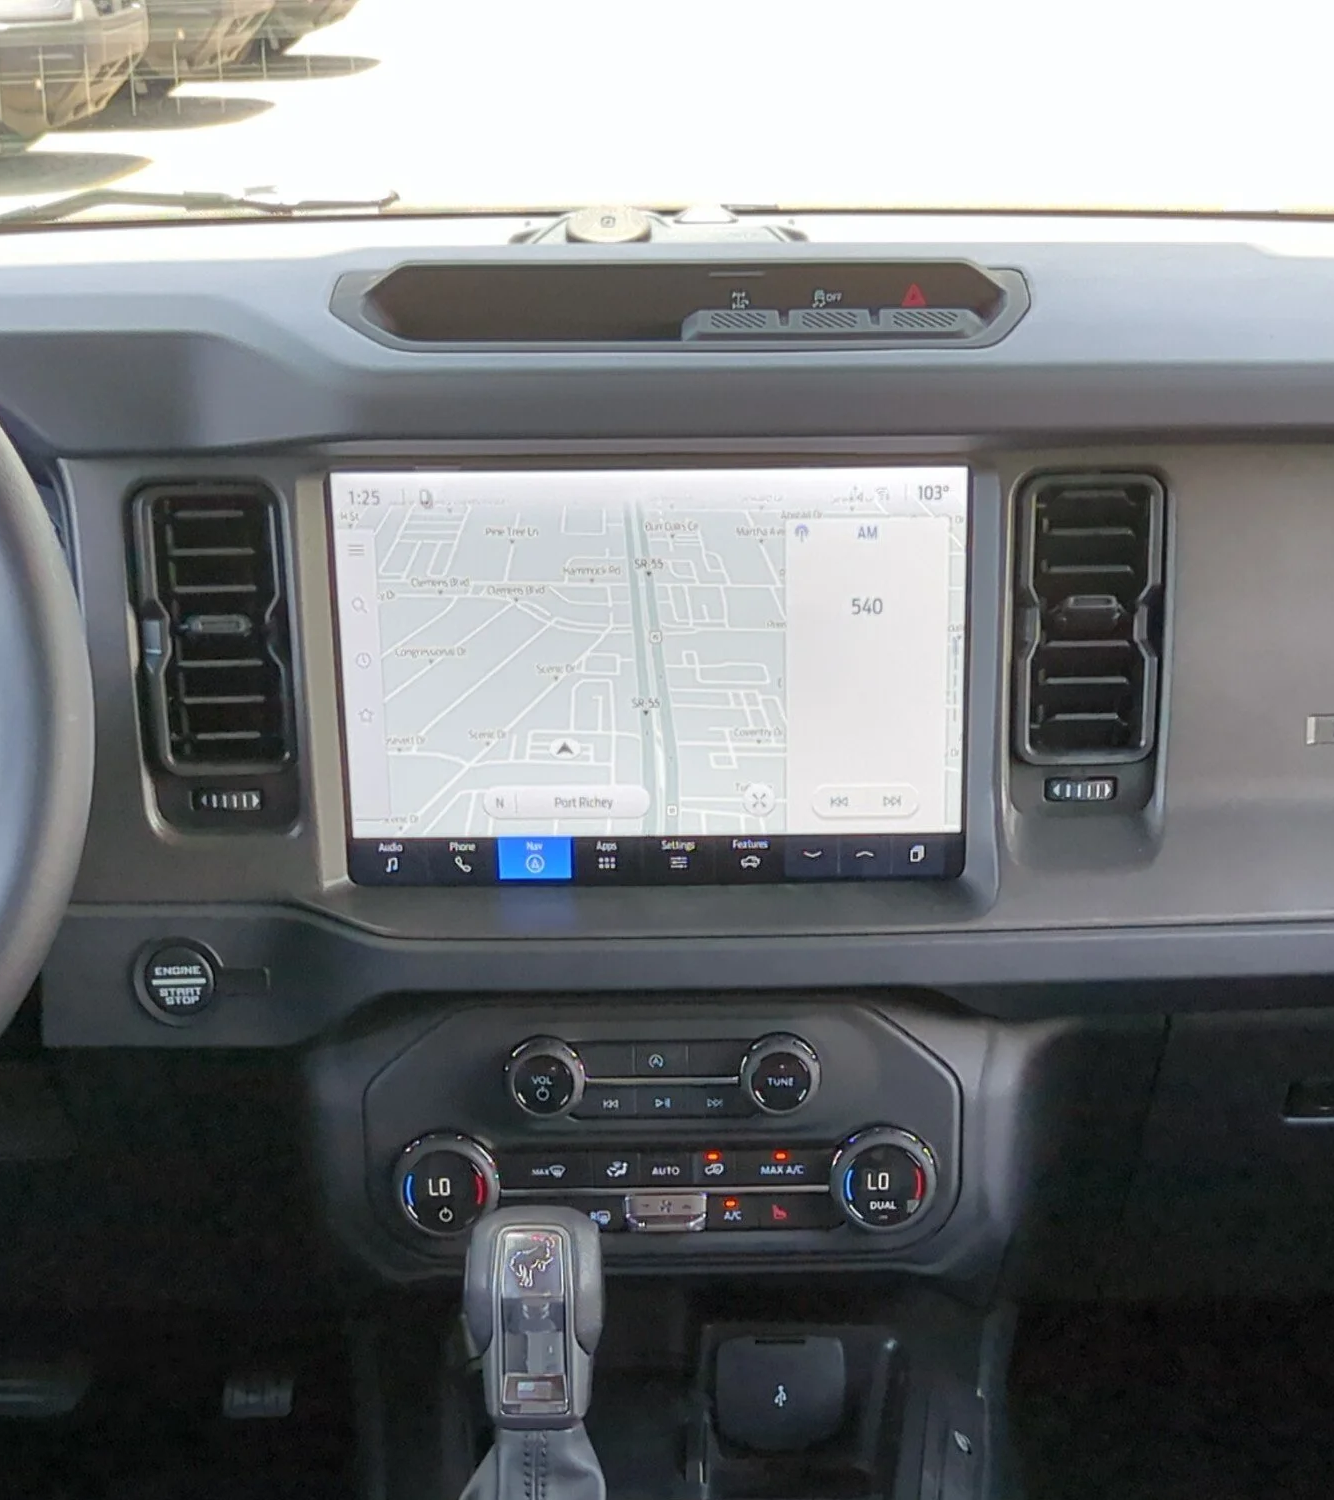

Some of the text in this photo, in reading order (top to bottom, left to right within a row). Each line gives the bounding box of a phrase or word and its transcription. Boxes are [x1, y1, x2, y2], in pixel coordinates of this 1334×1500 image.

[826, 293, 842, 303] OFF
[348, 490, 380, 506] 1:25
[917, 485, 950, 501] 103°
[485, 527, 504, 537] Pine
[857, 527, 878, 540] AM
[851, 598, 883, 615] 540
[496, 797, 504, 808] N
[554, 797, 614, 812] Port Richey
[378, 842, 403, 853] Audio
[449, 841, 476, 852] Phone
[526, 841, 543, 851] Nav
[596, 841, 617, 854] Apps
[661, 839, 695, 851] Settings
[732, 838, 769, 850] Features
[154, 965, 201, 976] ENGINE
[159, 987, 202, 997] START
[165, 995, 199, 1005] STOP
[531, 1076, 553, 1086] VOL
[767, 1077, 794, 1087] TUNE
[652, 1165, 680, 1176] AUTO
[760, 1165, 804, 1175] MAX A/C
[428, 1178, 451, 1197] LO
[867, 1173, 890, 1191] LO
[870, 1201, 897, 1210] DUAL
[723, 1211, 742, 1221] A/C
